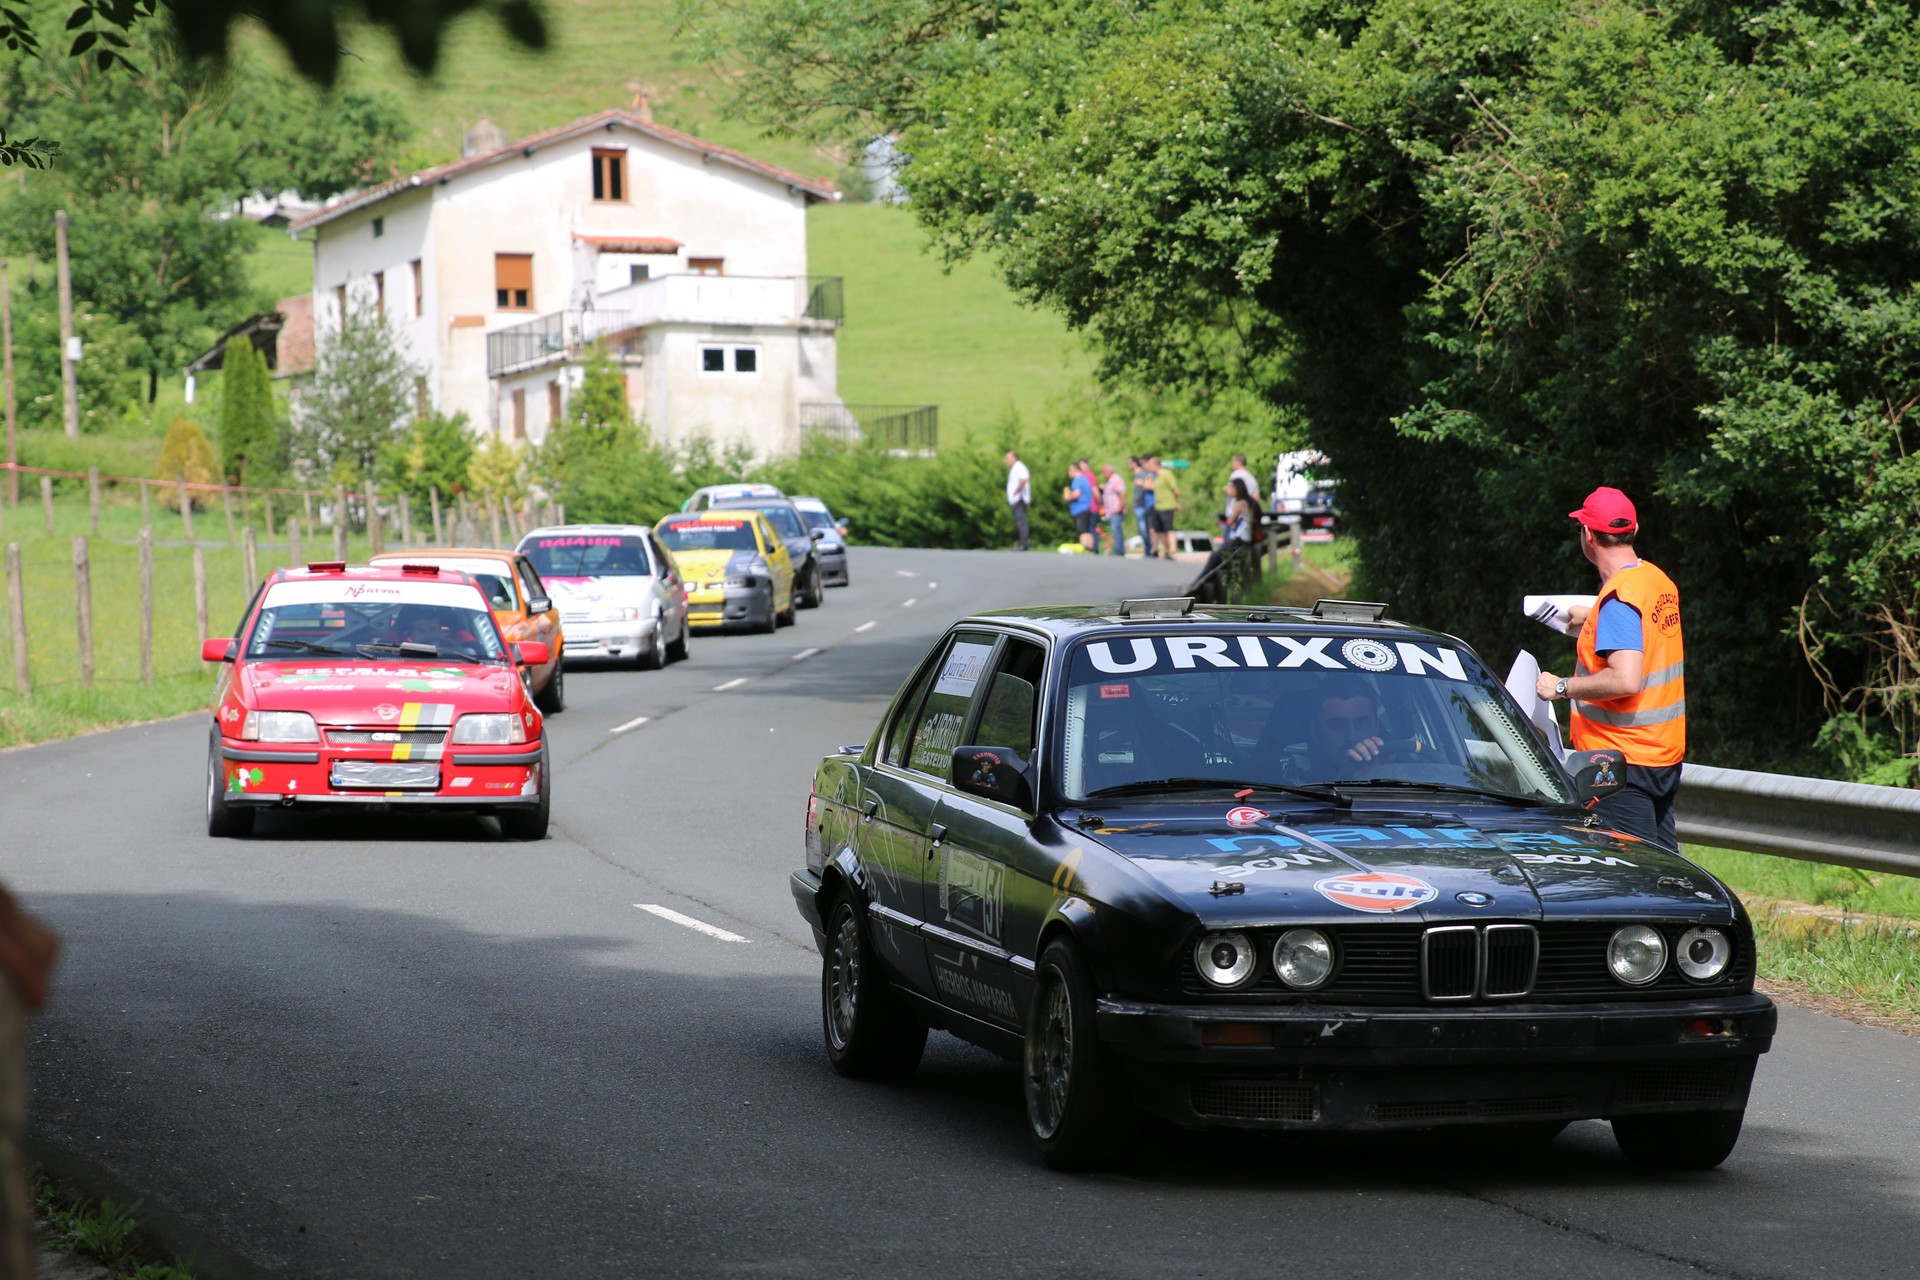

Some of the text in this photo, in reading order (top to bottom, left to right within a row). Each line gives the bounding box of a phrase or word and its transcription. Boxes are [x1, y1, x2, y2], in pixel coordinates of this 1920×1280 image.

[1086, 636, 1468, 681] URIXON
[1206, 824, 1583, 852] naira
[1324, 880, 1430, 900] Gulf
[935, 965, 1020, 1020] HIERROS NAPARRA
